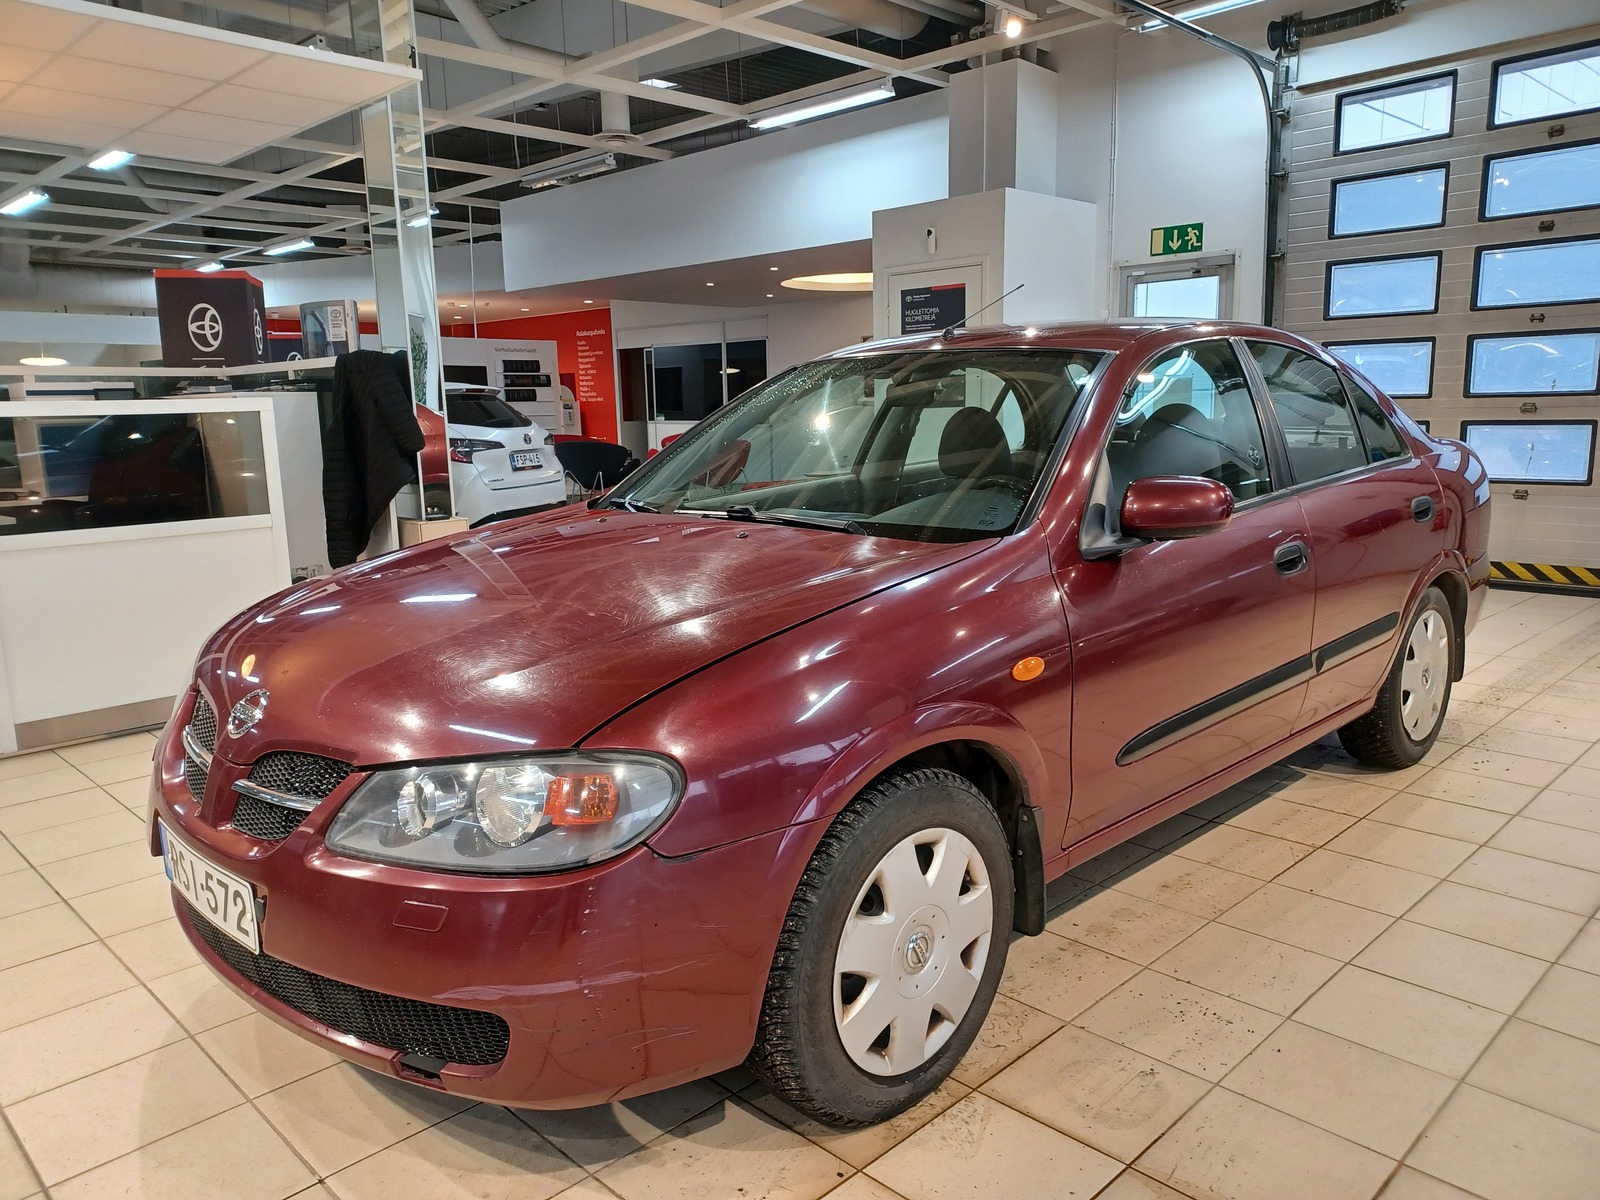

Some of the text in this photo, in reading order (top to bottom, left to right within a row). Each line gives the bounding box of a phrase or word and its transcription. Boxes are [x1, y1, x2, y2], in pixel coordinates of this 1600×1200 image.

[905, 307, 940, 316] HUOLETTOMIA
[905, 314, 937, 322] KILOMETREJÄ
[515, 453, 541, 466] FSP-415
[168, 839, 250, 938] RSI-572
